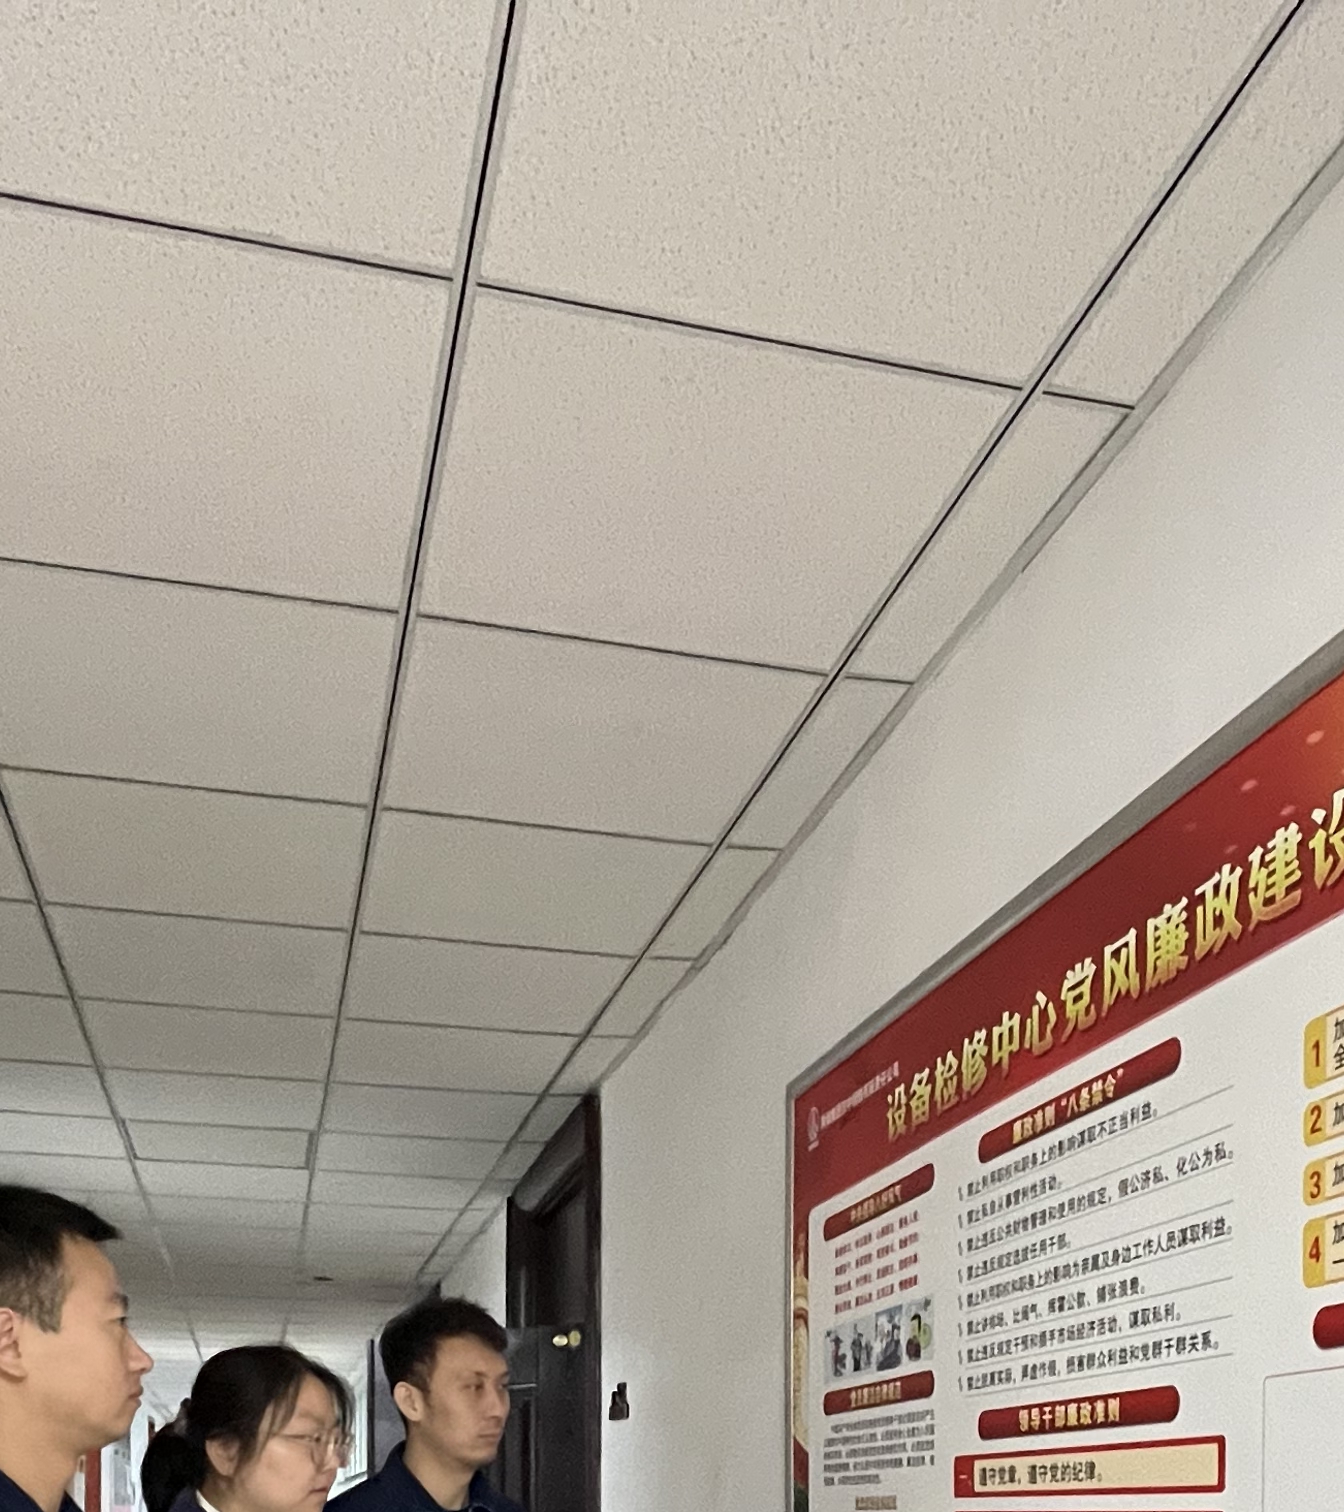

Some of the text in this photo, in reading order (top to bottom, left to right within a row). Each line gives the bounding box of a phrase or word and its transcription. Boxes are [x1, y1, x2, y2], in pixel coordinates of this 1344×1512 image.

[1311, 1039, 1322, 1069] 1
[1310, 1105, 1323, 1135] 2
[1309, 1170, 1322, 1199] 3
[1308, 1235, 1322, 1264] 4
